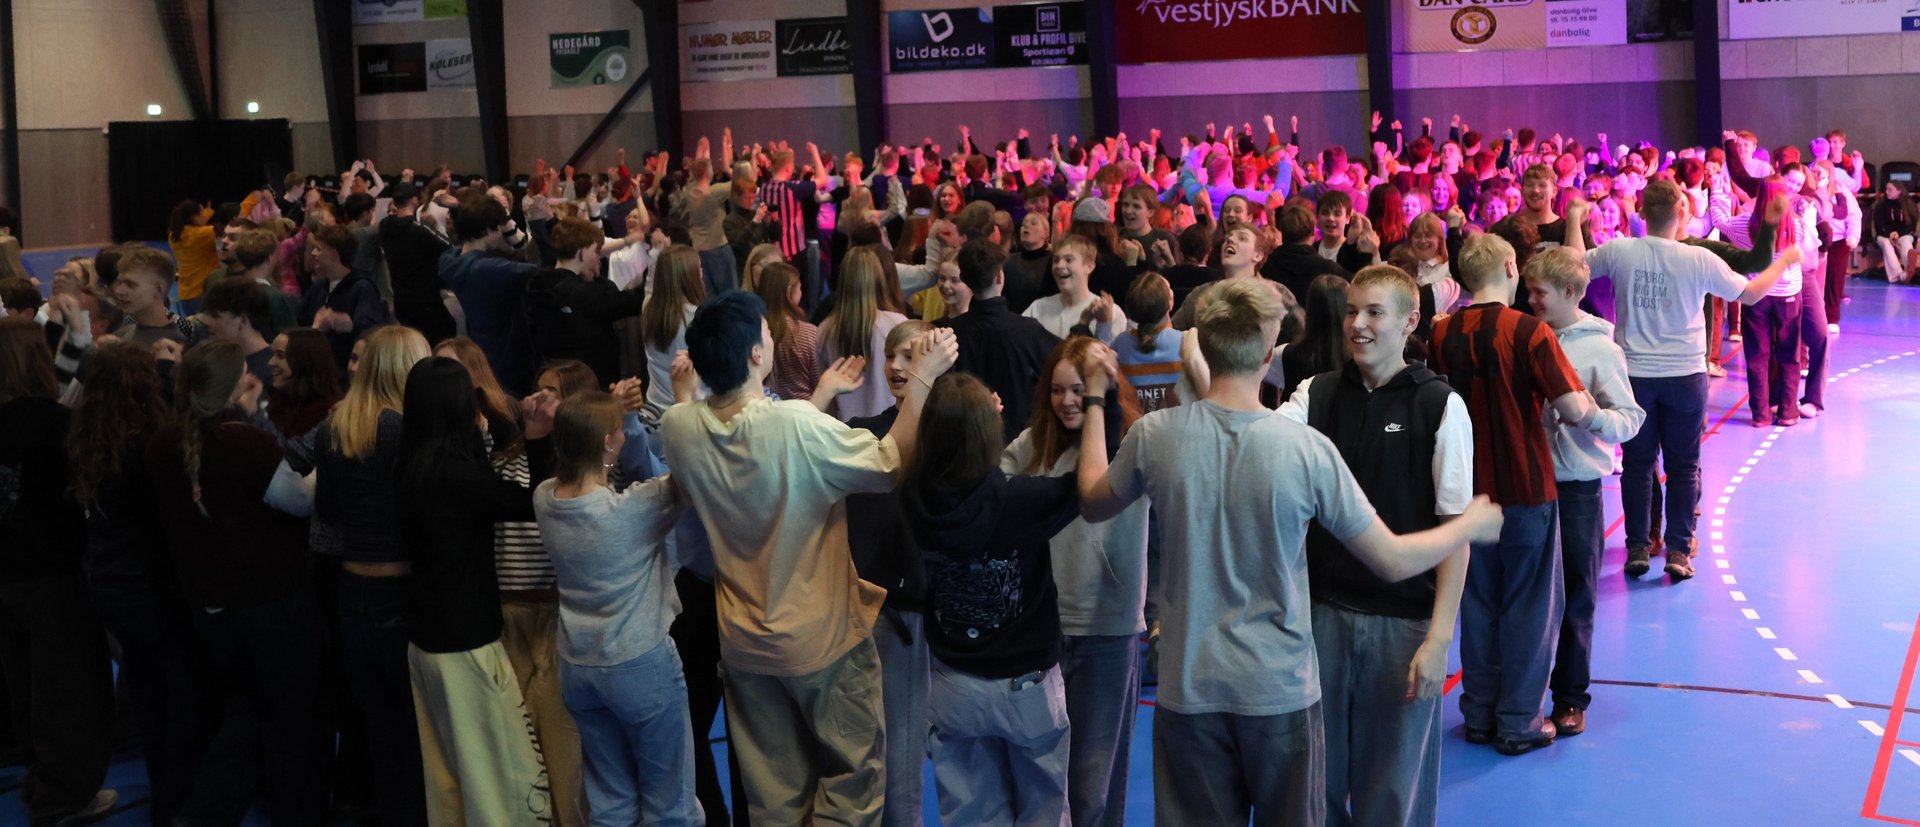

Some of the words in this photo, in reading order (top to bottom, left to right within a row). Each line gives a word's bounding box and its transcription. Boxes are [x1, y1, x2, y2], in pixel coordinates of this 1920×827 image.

[1550, 27, 1590, 38] danbolig
[782, 28, 852, 55] Lindbe
[896, 43, 986, 60] bildeko.dk
[1137, 387, 1168, 400] ANET
